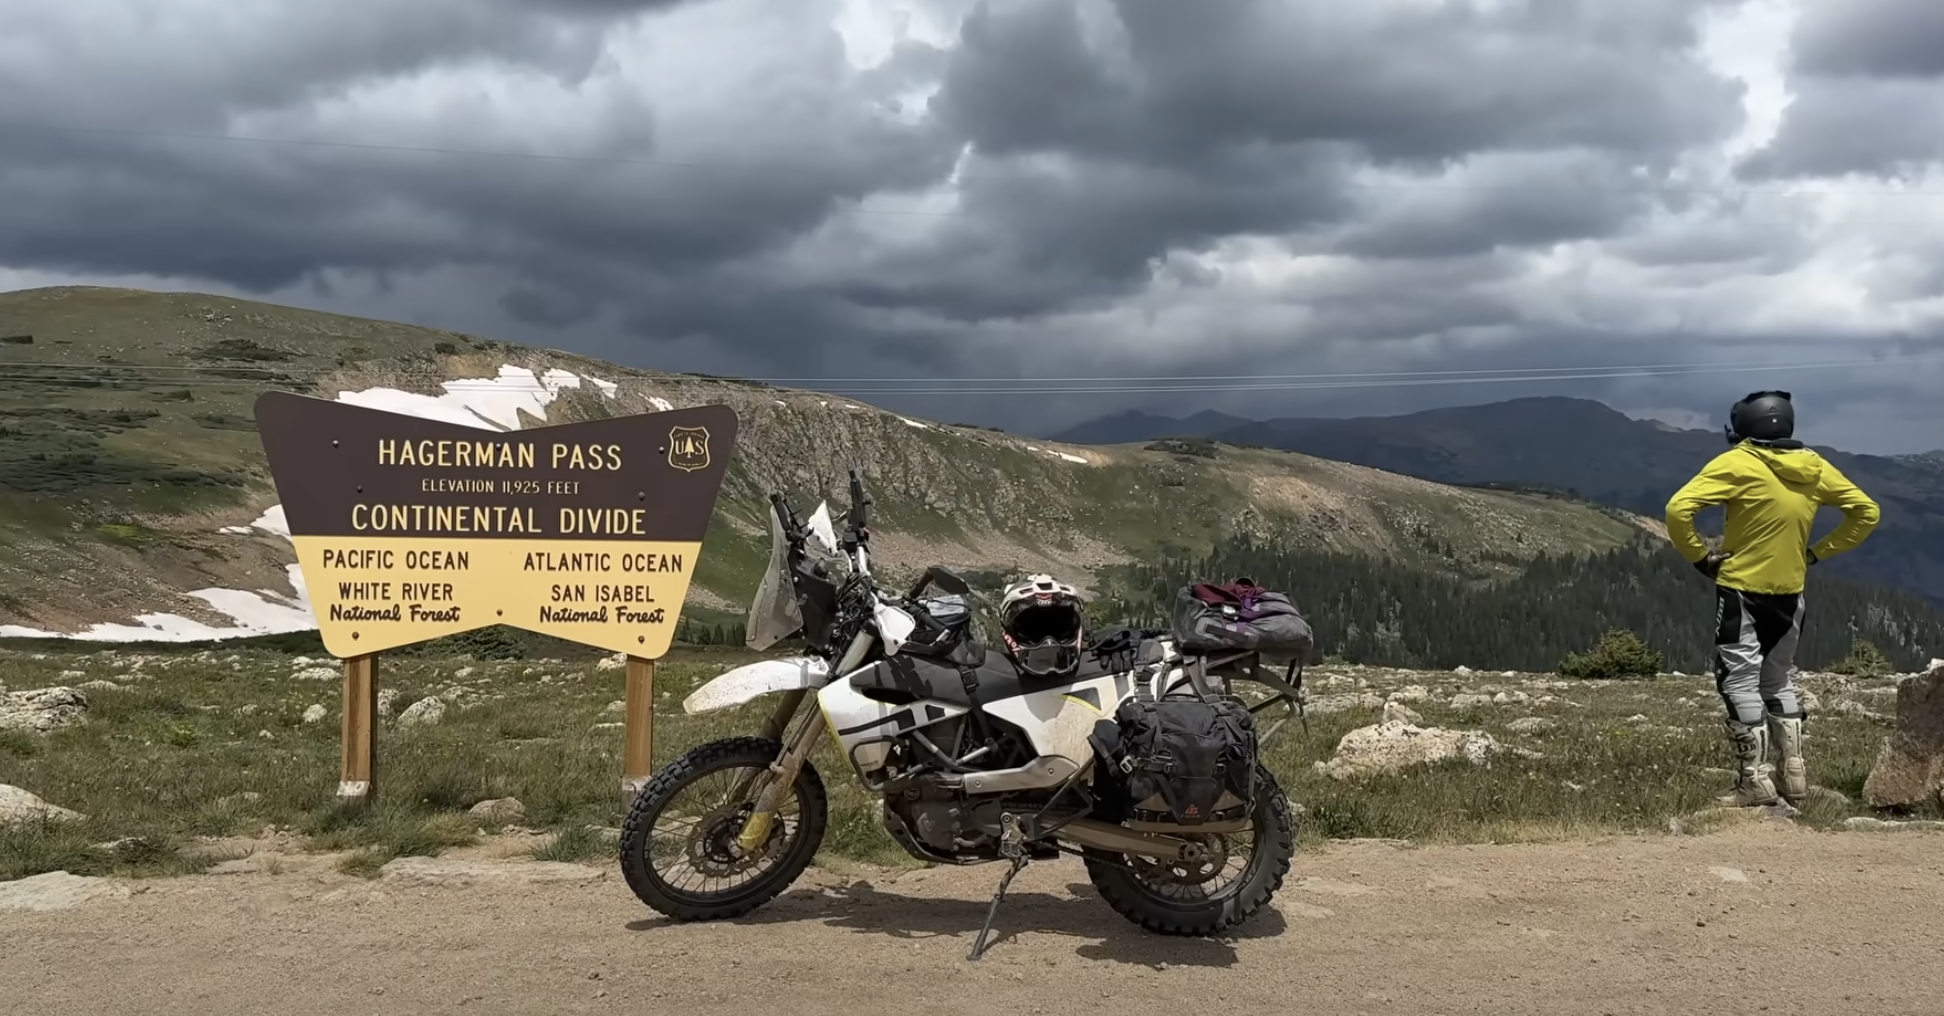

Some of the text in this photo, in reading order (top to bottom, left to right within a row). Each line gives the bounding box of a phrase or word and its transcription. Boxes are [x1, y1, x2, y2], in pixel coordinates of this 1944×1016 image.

[379, 439, 622, 471] HAGERMAN PASS
[422, 479, 579, 495] ELEVATION 11,925 FEET
[351, 504, 646, 534] CONTINENTAL DIVIDE
[323, 550, 469, 570] PACIFIC OCEAN
[524, 553, 682, 573] ATLANTIC OCEAN
[338, 583, 453, 601] WHITE RIVER
[551, 585, 655, 602] SAN ISABEL
[329, 604, 460, 623] National Forest
[539, 606, 665, 624] National Forest
